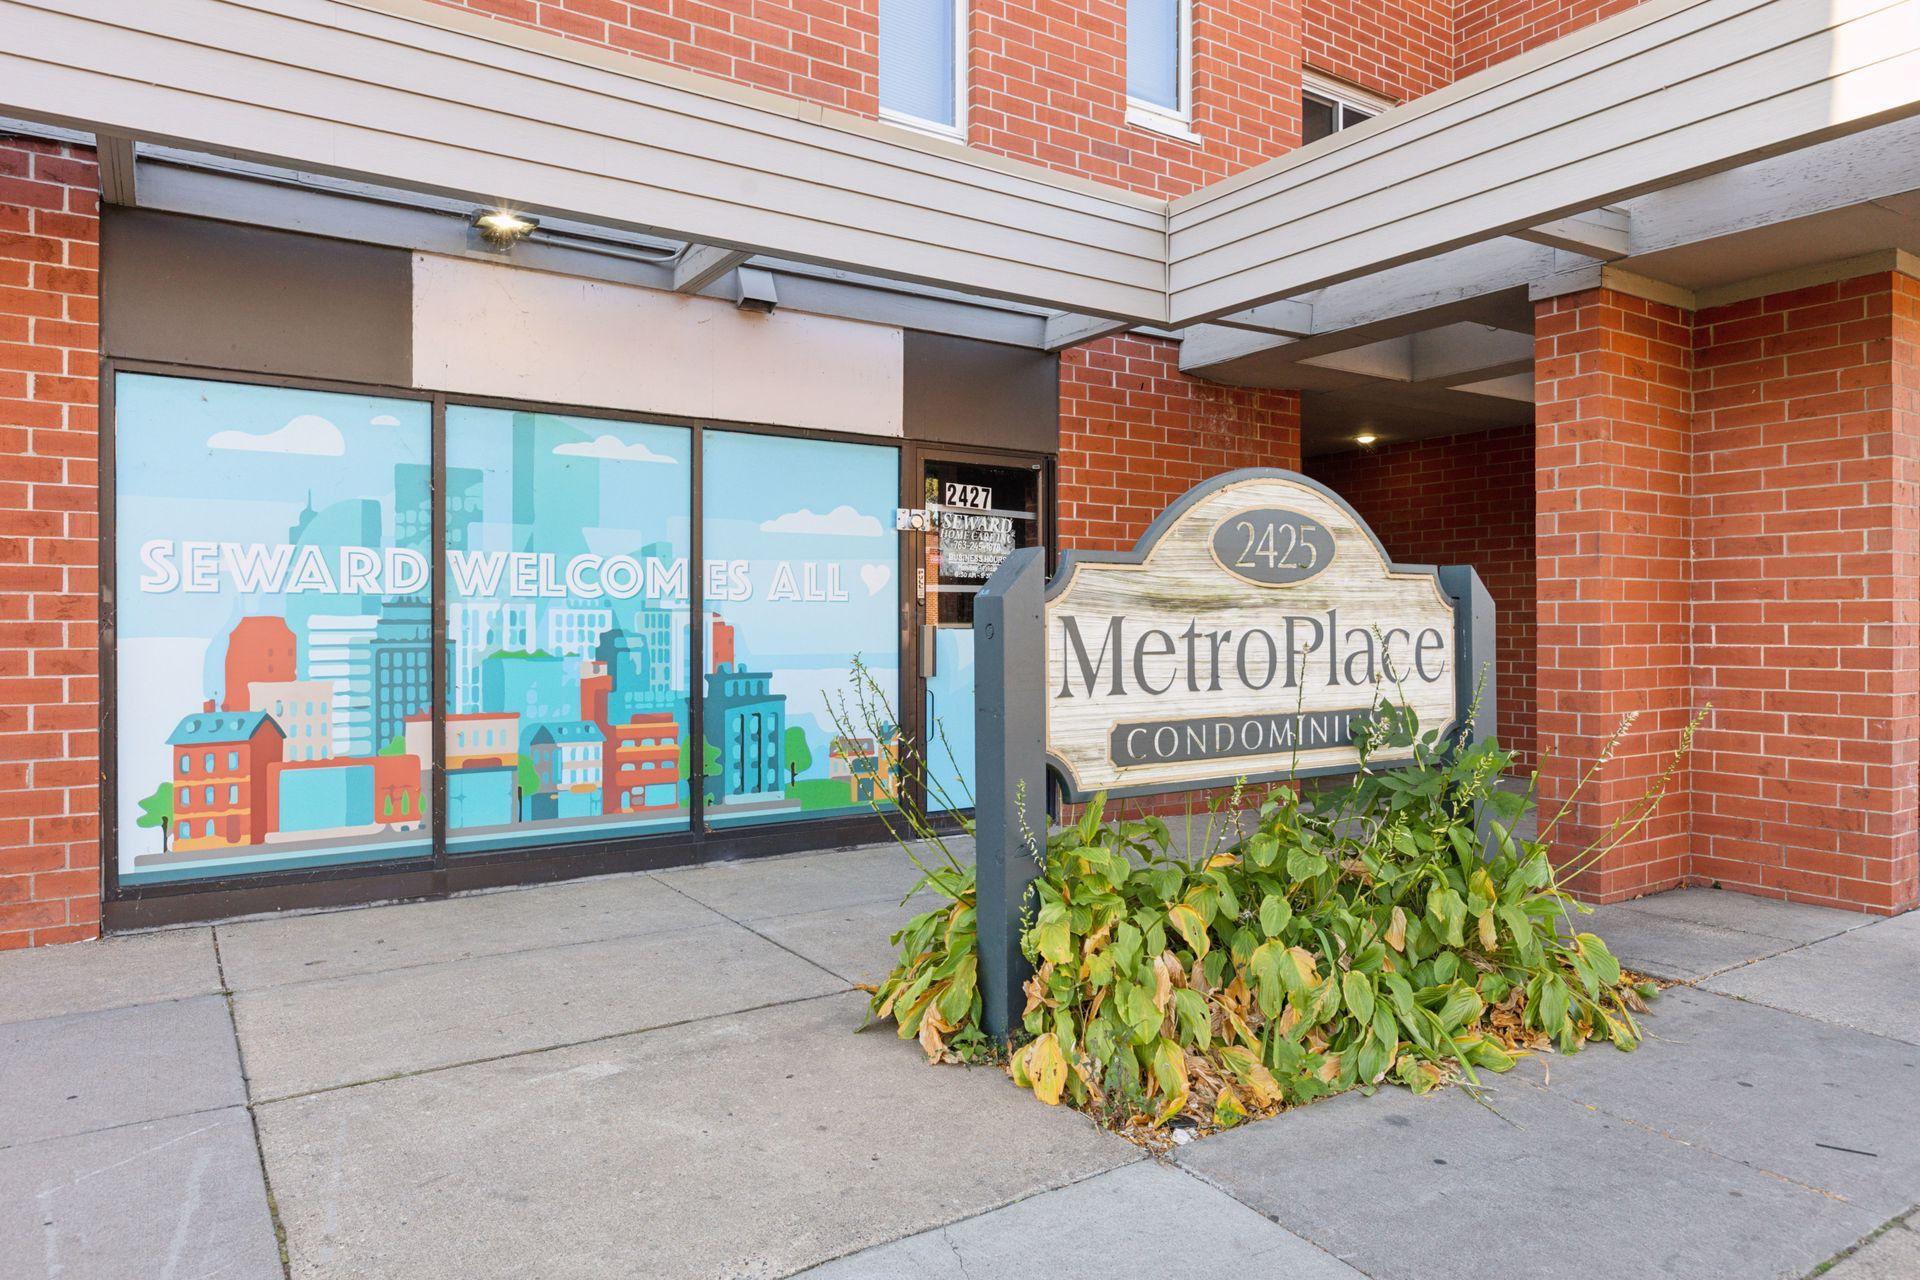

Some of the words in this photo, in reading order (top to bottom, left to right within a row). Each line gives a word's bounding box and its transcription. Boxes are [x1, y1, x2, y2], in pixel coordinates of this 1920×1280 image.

[947, 484, 991, 509] 2427
[940, 529, 969, 539] HOME
[971, 531, 995, 541] CARE
[942, 513, 1013, 532] SEWARD
[948, 553, 983, 562] BUSINESS
[1234, 521, 1317, 570] 2425
[140, 539, 430, 595] SEWARD
[445, 550, 753, 602] WELCOMES
[769, 560, 850, 602] ALL
[1056, 609, 1445, 699] MetroPlace
[1127, 711, 1404, 760] CONDOMINIU
